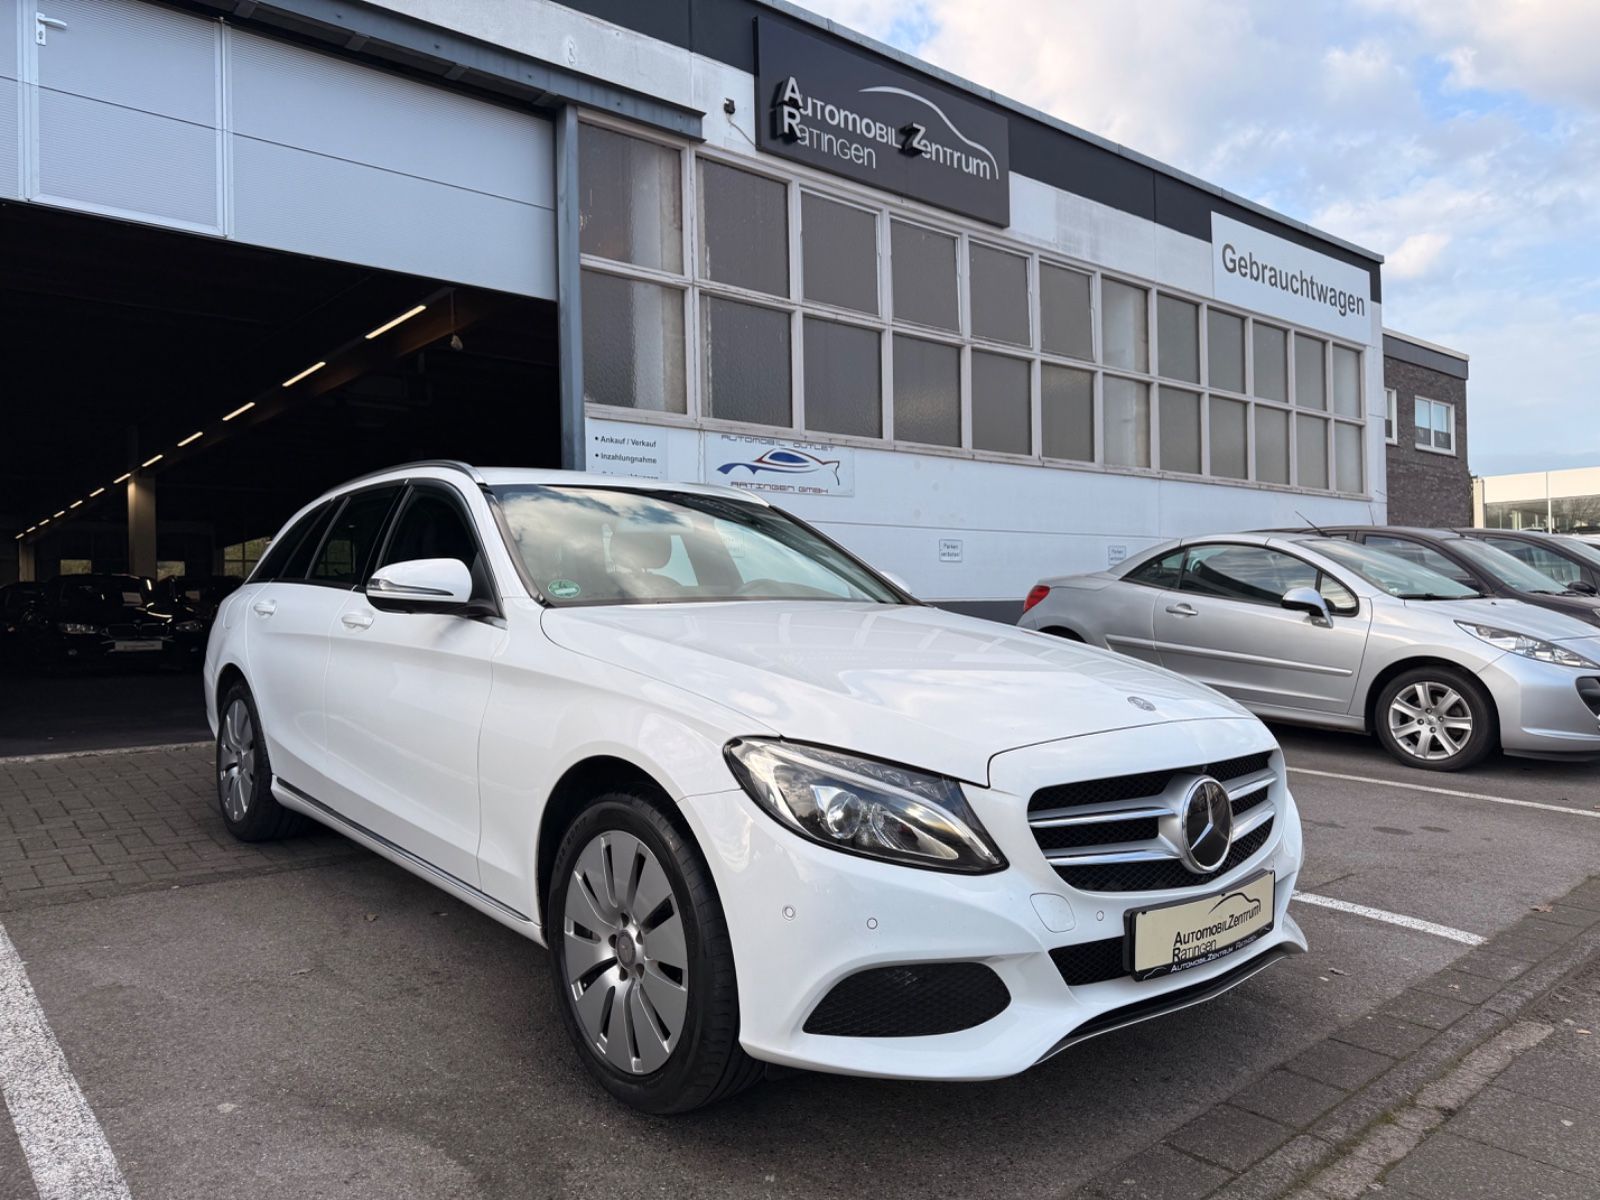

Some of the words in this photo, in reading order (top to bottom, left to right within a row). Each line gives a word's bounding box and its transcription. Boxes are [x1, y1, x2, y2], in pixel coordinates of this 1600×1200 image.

[1222, 243, 1365, 317] Gebrauchtwagen
[600, 435, 625, 445] Ankauf
[631, 438, 656, 448] Verkauf
[793, 440, 835, 452] OUTLET
[600, 452, 657, 464] Inzahlungnahme
